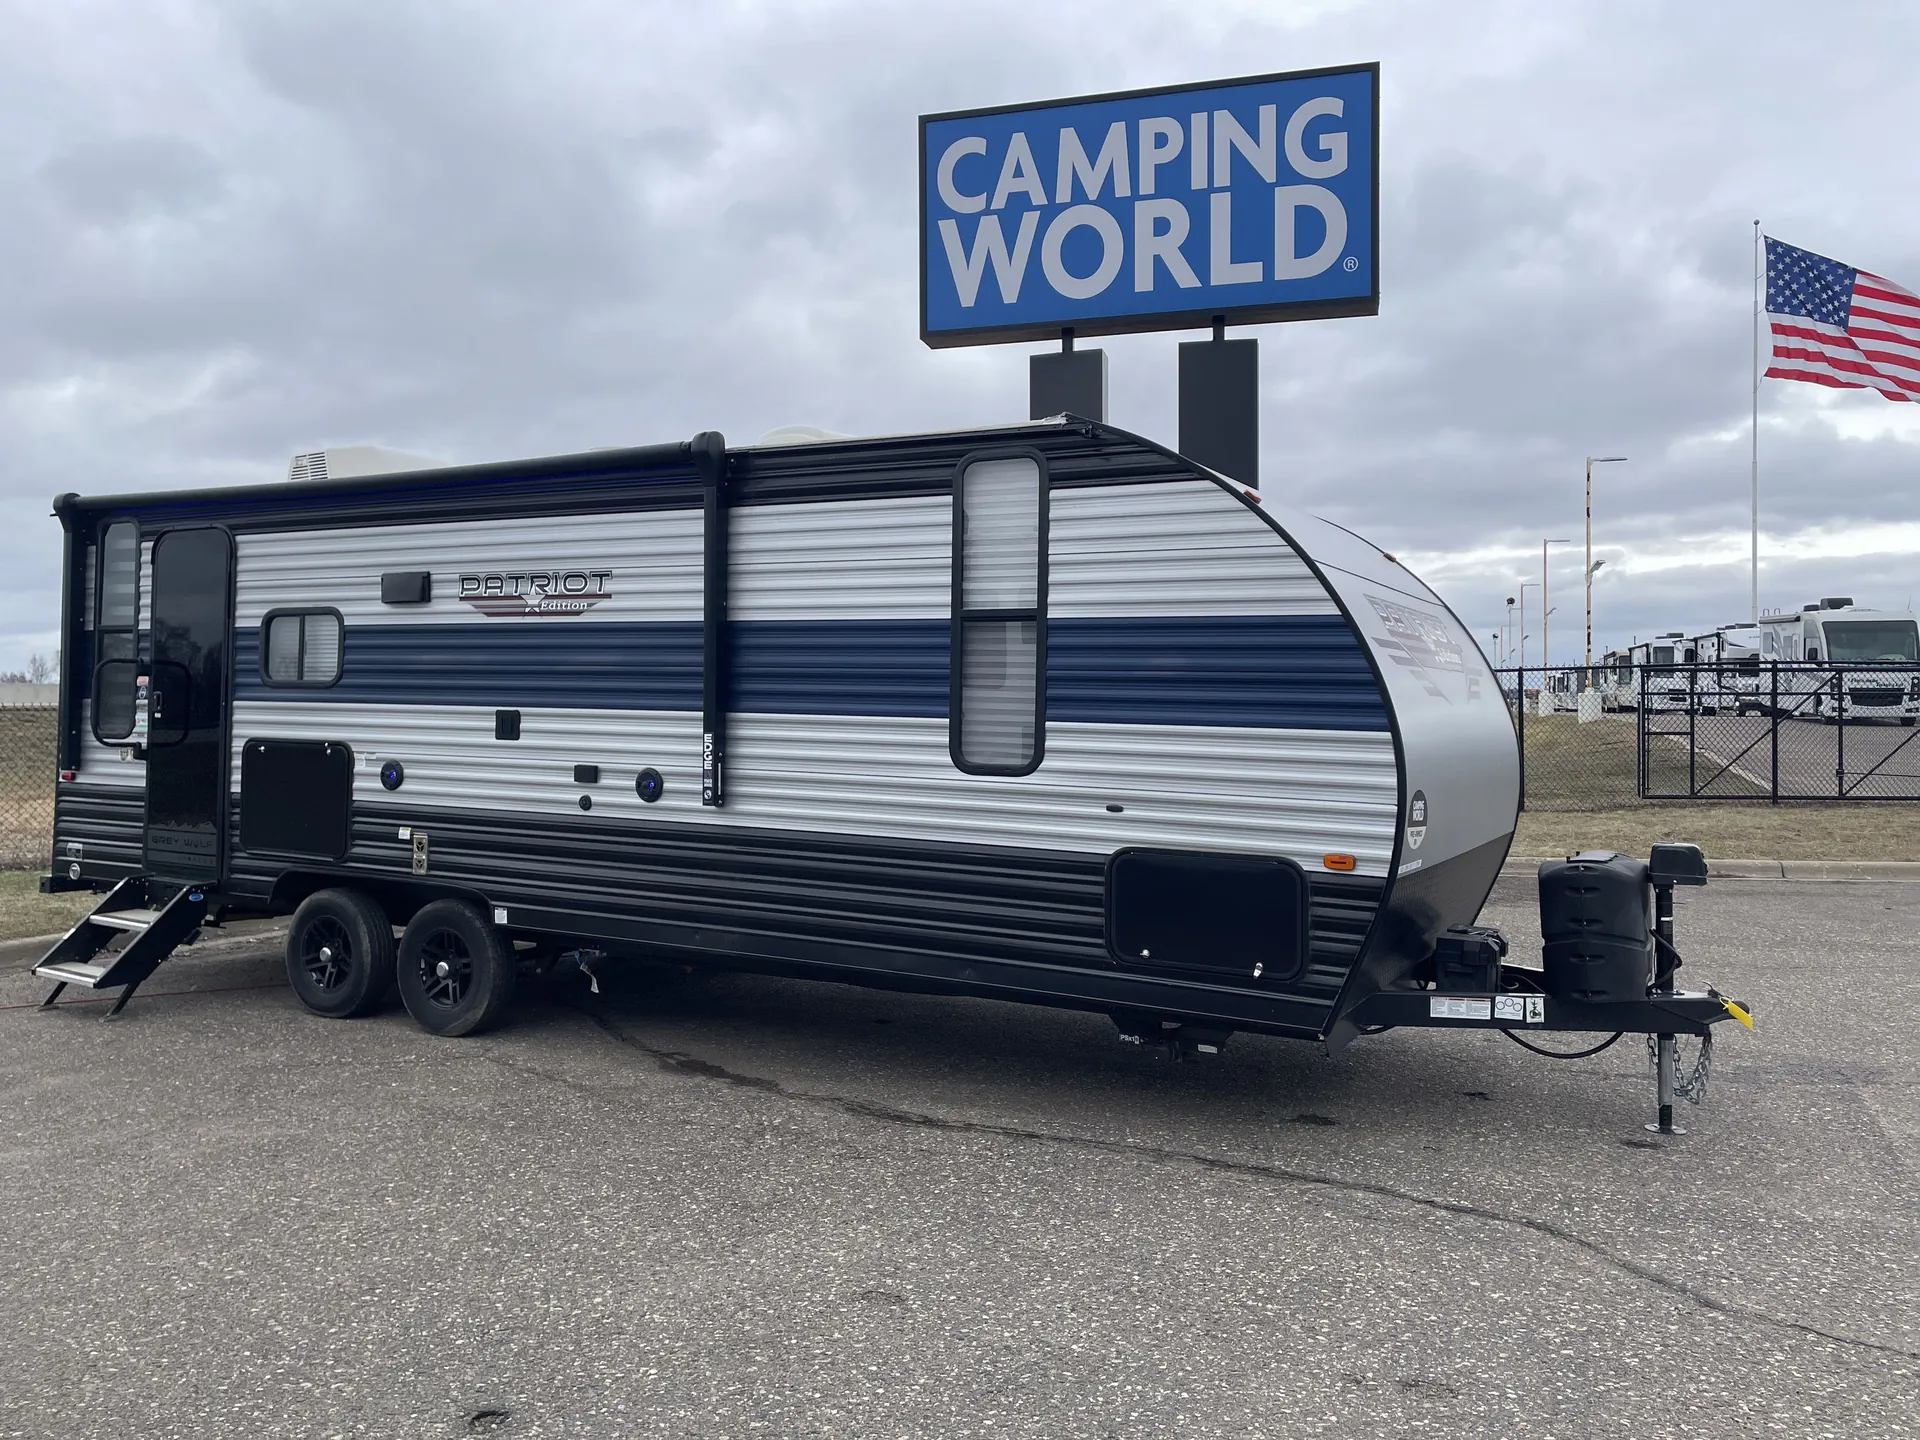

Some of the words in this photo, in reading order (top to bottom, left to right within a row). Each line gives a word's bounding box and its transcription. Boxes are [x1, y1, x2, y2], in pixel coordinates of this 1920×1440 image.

[937, 96, 1349, 214] CAMPING
[937, 184, 1349, 308] WORLD
[459, 570, 613, 597] PATRIOT
[540, 600, 588, 611] Edition
[703, 733, 713, 770] EDGE
[151, 835, 179, 845] GREY
